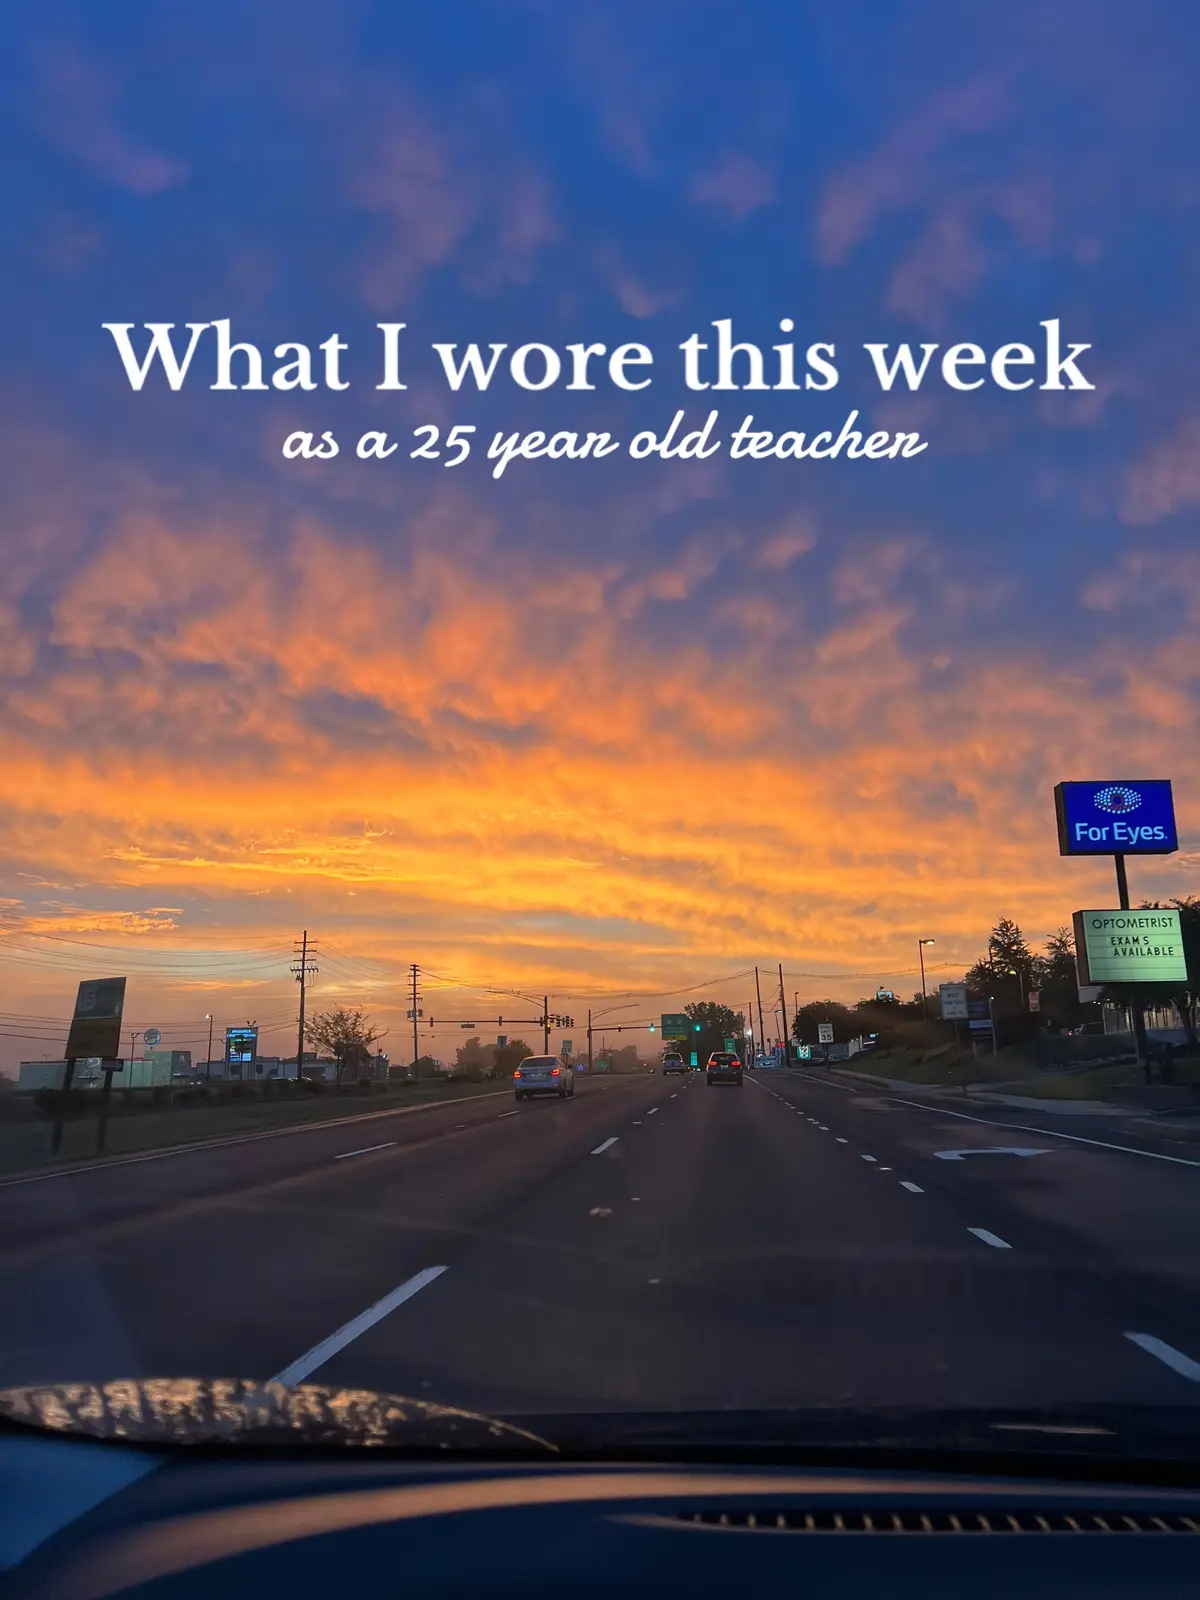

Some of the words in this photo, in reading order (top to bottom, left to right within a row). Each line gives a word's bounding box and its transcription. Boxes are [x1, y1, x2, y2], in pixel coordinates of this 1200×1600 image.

[1075, 822, 1110, 841] For
[1092, 917, 1173, 930] OPTOMETRIST
[1113, 946, 1175, 957] AVAILABLE
